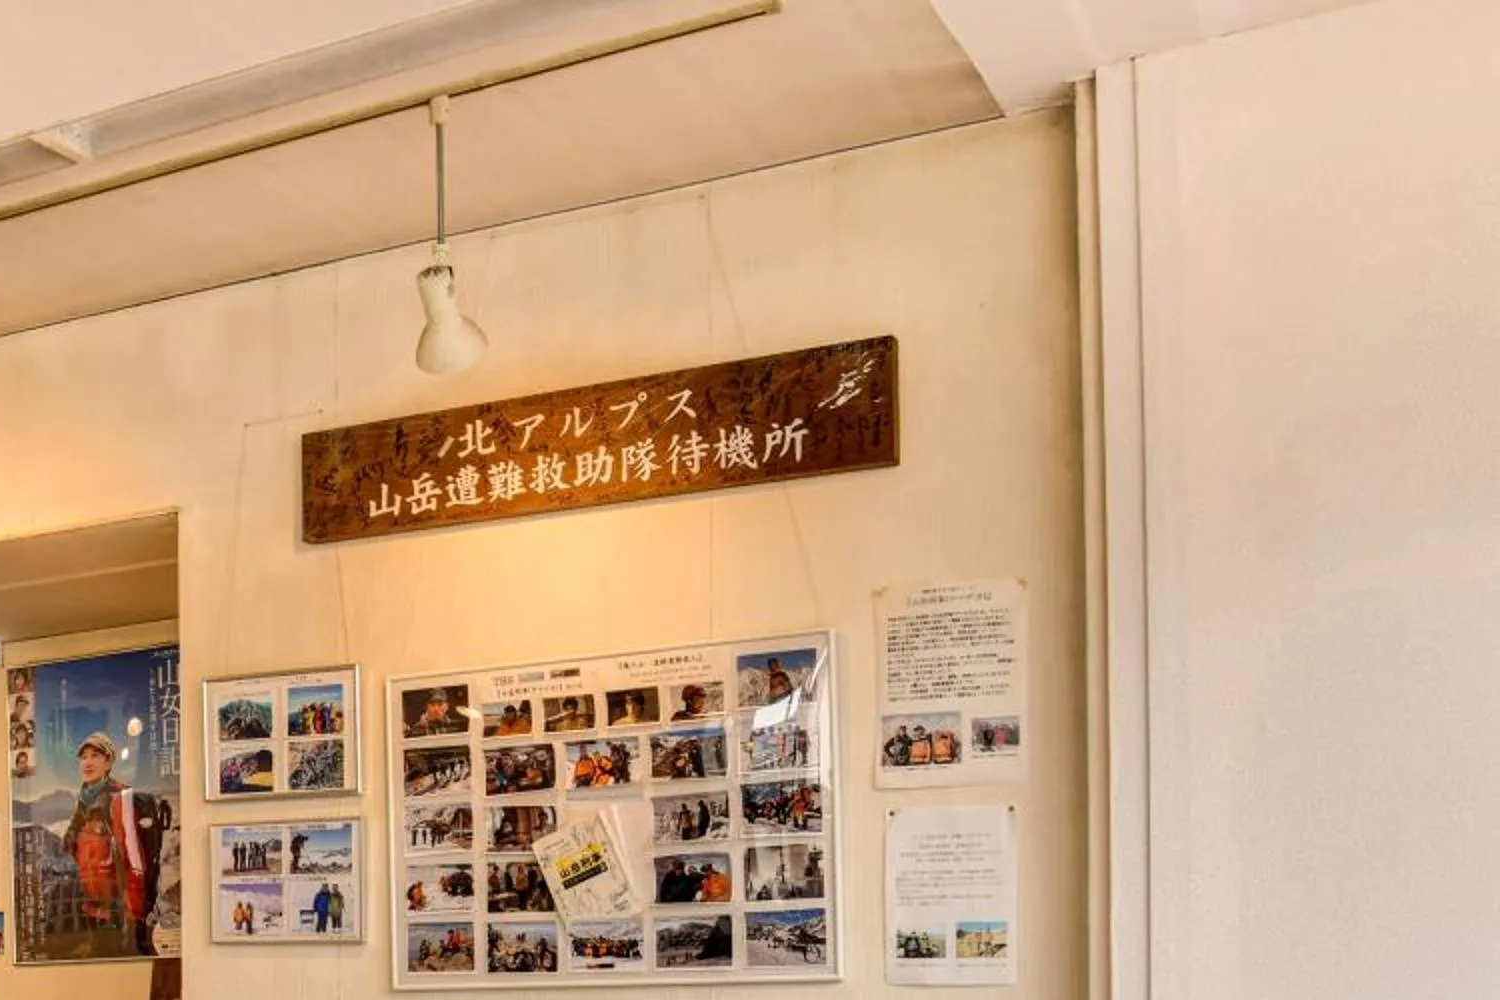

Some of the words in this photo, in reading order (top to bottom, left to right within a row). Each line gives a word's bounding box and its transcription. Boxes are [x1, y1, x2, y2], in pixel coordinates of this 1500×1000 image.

[368, 417, 810, 519] 山岳遭難救助隊待機所
